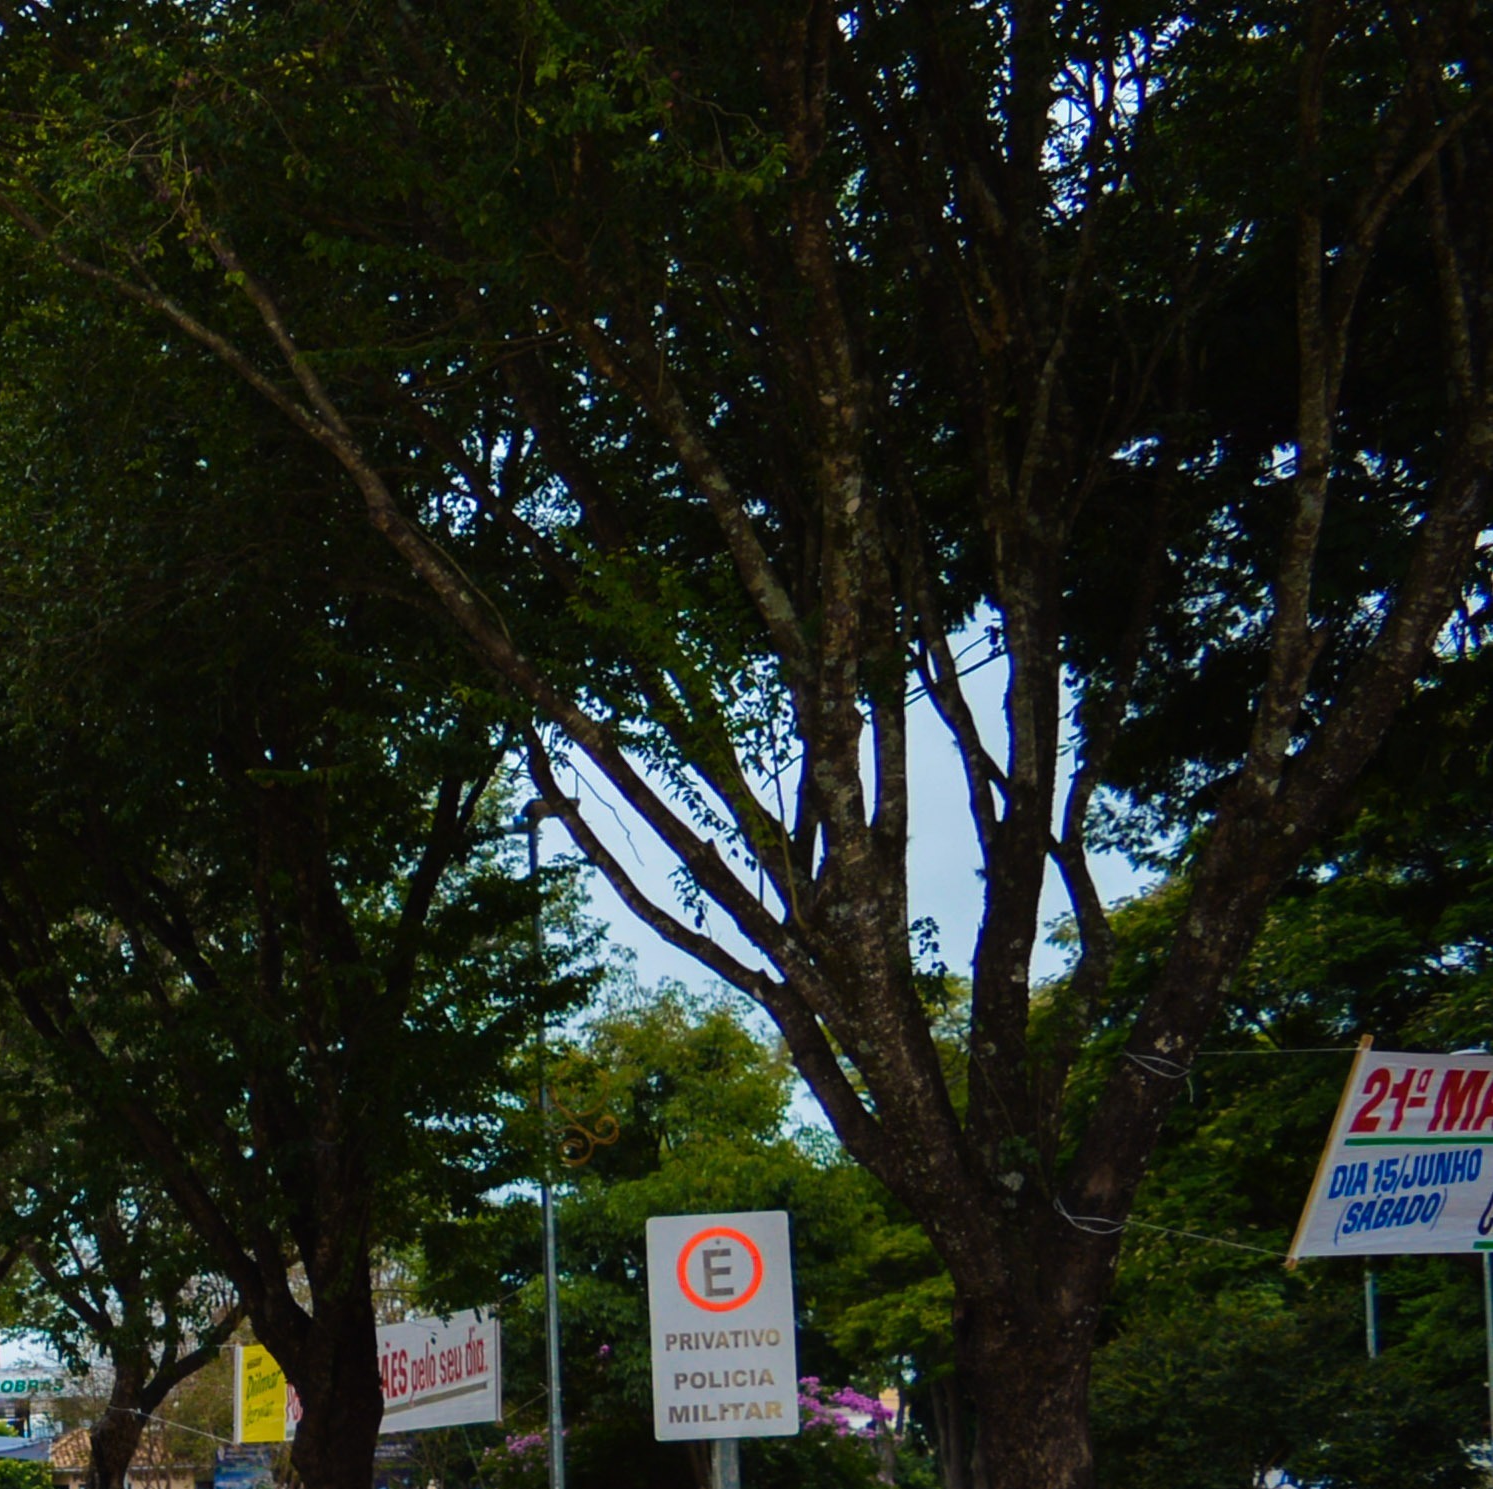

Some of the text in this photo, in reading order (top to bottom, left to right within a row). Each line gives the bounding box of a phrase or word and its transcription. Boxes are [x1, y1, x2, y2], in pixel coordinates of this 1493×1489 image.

[1328, 1148, 1483, 1199] DIA 15/JUNHO
[702, 1248, 734, 1297] E
[665, 1328, 781, 1351] PRIVATIVO
[380, 1341, 408, 1399] ÃES
[409, 1341, 436, 1406] pelo
[440, 1345, 463, 1385] seu
[674, 1368, 775, 1390] POLICIA
[668, 1402, 783, 1424] MILITAR
